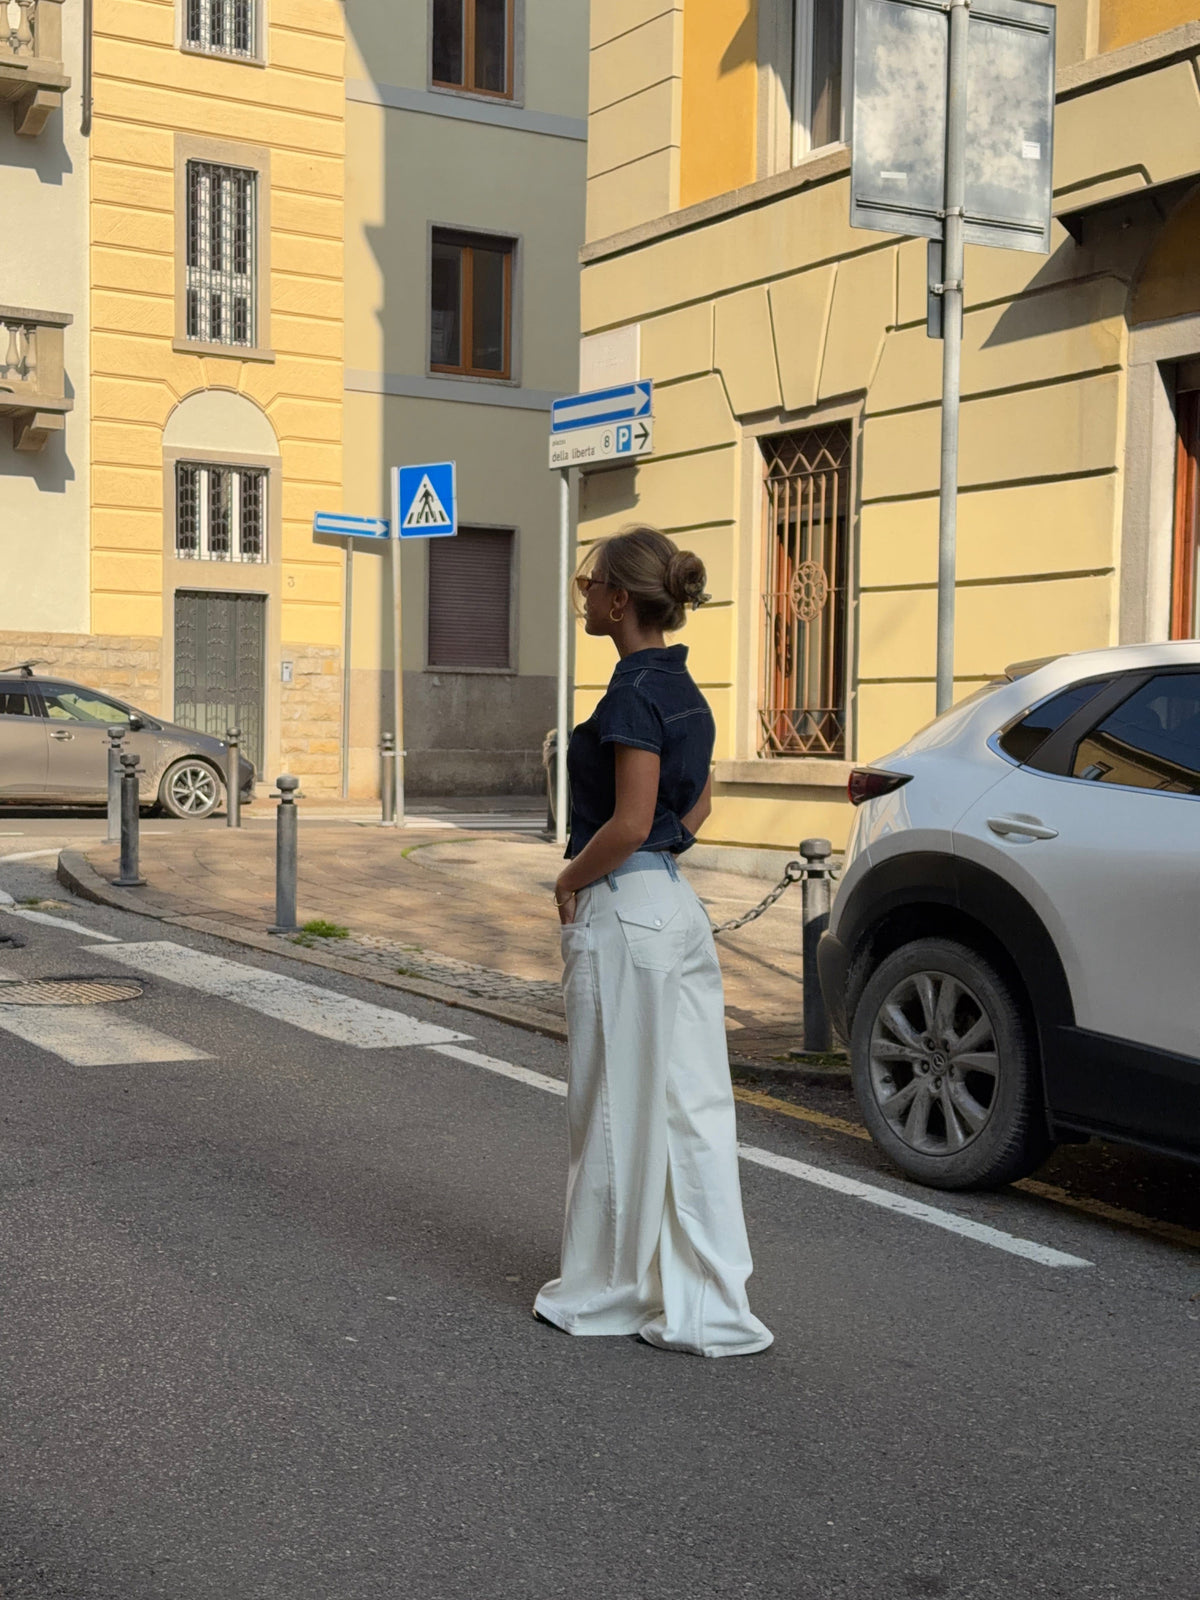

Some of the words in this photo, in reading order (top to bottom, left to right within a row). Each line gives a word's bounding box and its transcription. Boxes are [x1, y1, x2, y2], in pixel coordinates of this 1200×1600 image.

[604, 435, 610, 448] 8
[619, 427, 630, 451] P
[552, 450, 569, 462] della
[287, 576, 296, 588] 3
